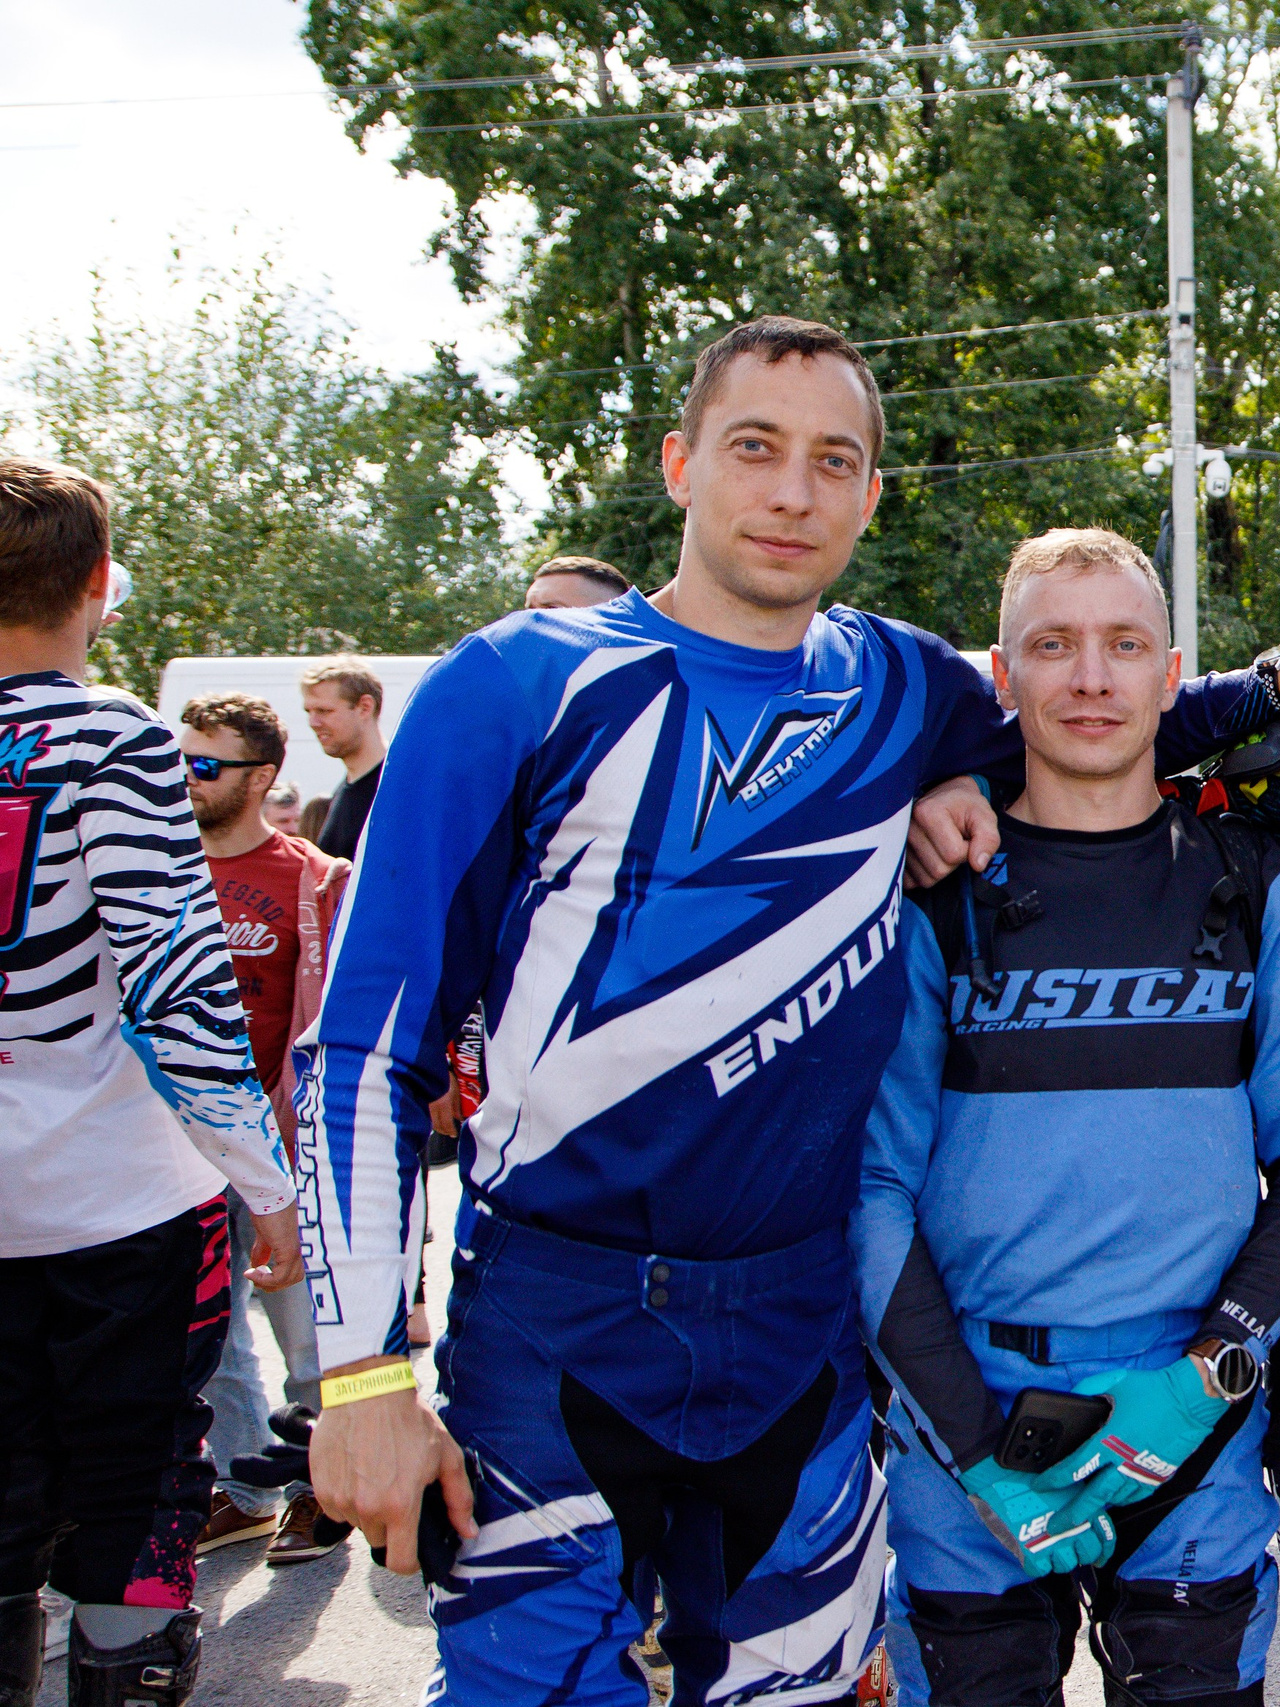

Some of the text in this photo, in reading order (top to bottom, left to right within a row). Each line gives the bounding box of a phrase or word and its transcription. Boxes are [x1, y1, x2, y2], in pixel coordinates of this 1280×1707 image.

[212, 878, 284, 922] EGEND
[703, 879, 901, 1098] ENDUR
[955, 1018, 1041, 1035] RACING
[1220, 1299, 1266, 1339] HELLA
[334, 1367, 404, 1397] ЗАТЕРЯННЫЙ
[1072, 1452, 1101, 1482] LEATT
[1133, 1449, 1179, 1478] LEATT
[1178, 1539, 1199, 1577] HELLA
